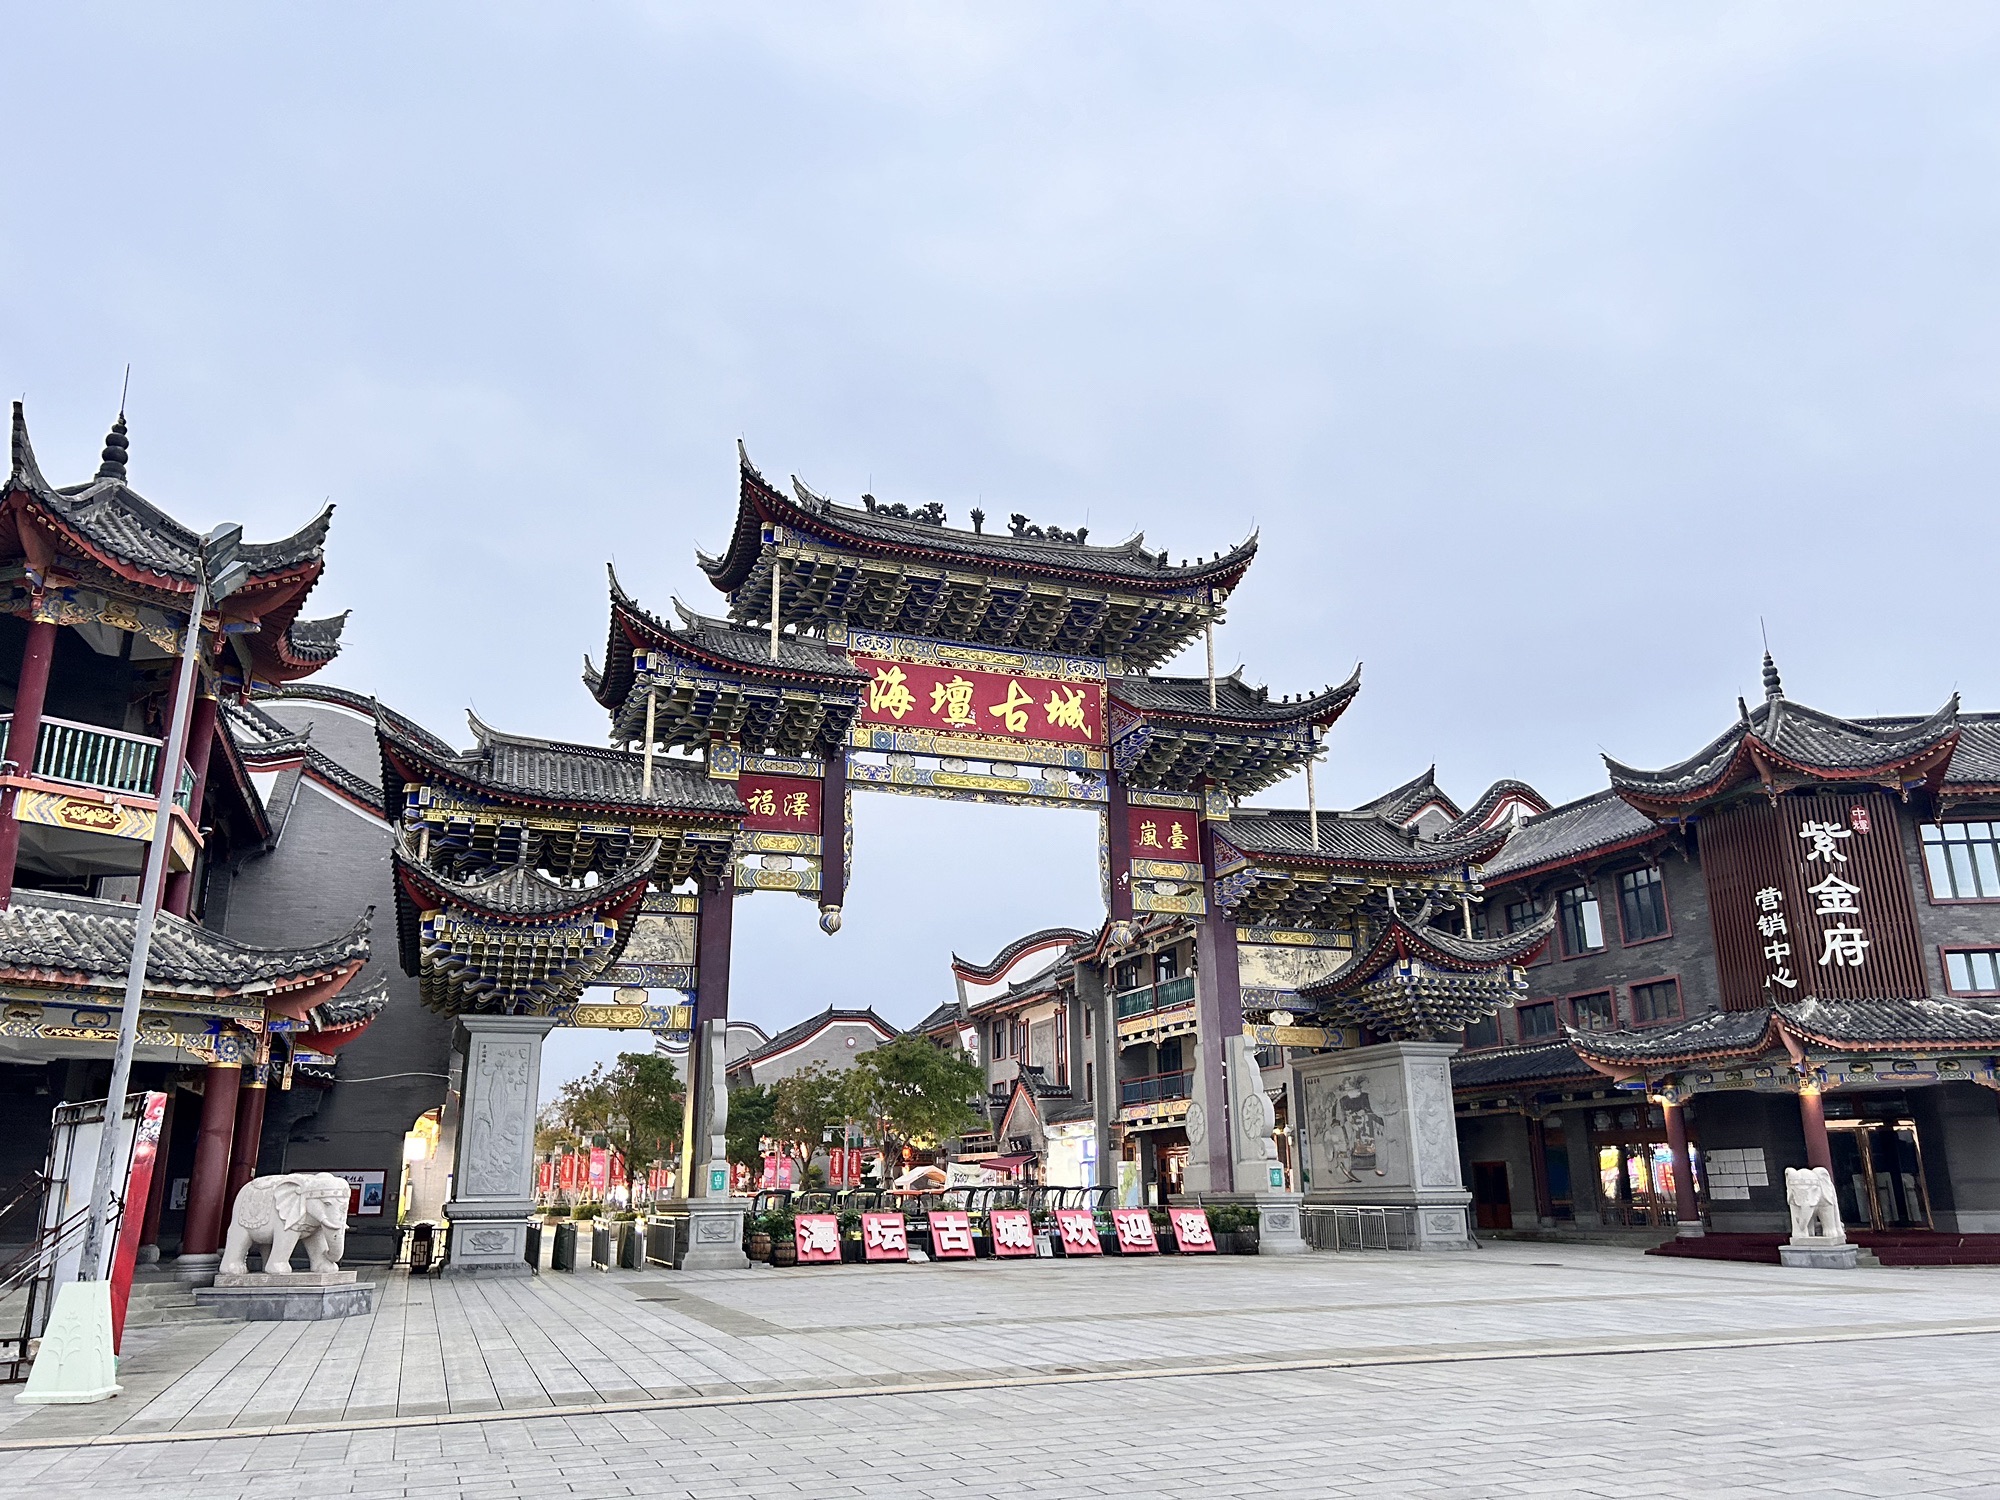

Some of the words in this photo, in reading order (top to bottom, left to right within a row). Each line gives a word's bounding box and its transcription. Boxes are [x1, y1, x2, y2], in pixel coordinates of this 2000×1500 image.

[870, 666, 1092, 740] 海壇古城
[747, 788, 811, 821] 福澤
[1139, 820, 1189, 850] 嵐臺
[1799, 820, 1870, 967] 紫金府
[1755, 887, 1797, 988] 营销中心
[800, 1213, 1212, 1253] 海坛古城欢迎您
